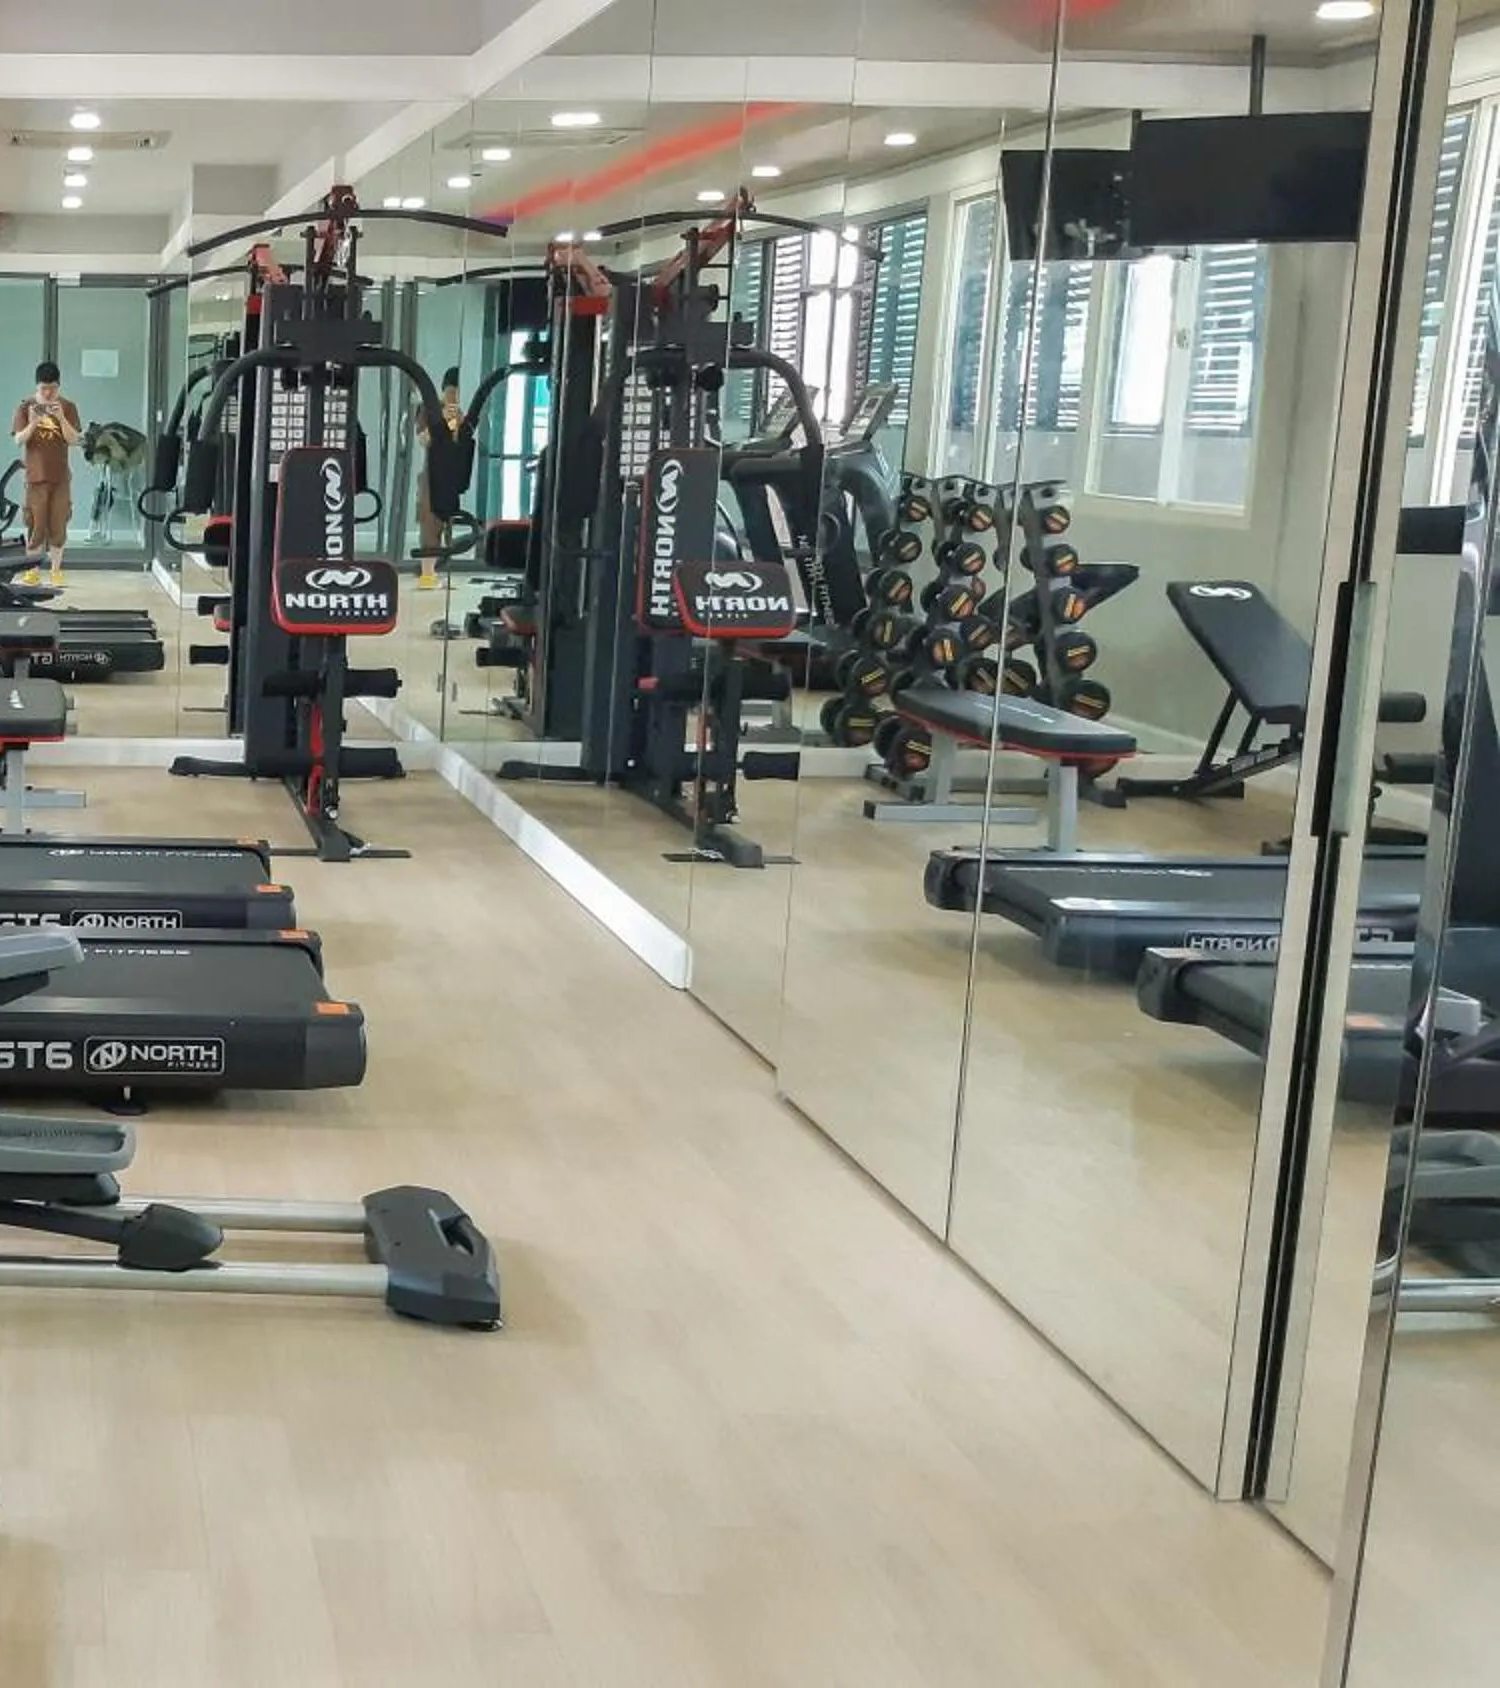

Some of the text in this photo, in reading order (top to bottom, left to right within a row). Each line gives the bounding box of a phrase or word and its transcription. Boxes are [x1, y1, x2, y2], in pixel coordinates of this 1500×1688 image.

[325, 513, 344, 561] NO
[285, 593, 388, 609] NORTH
[107, 916, 177, 929] NORTH
[131, 1045, 218, 1061] NORTH
[167, 1061, 218, 1069] FITNESS
